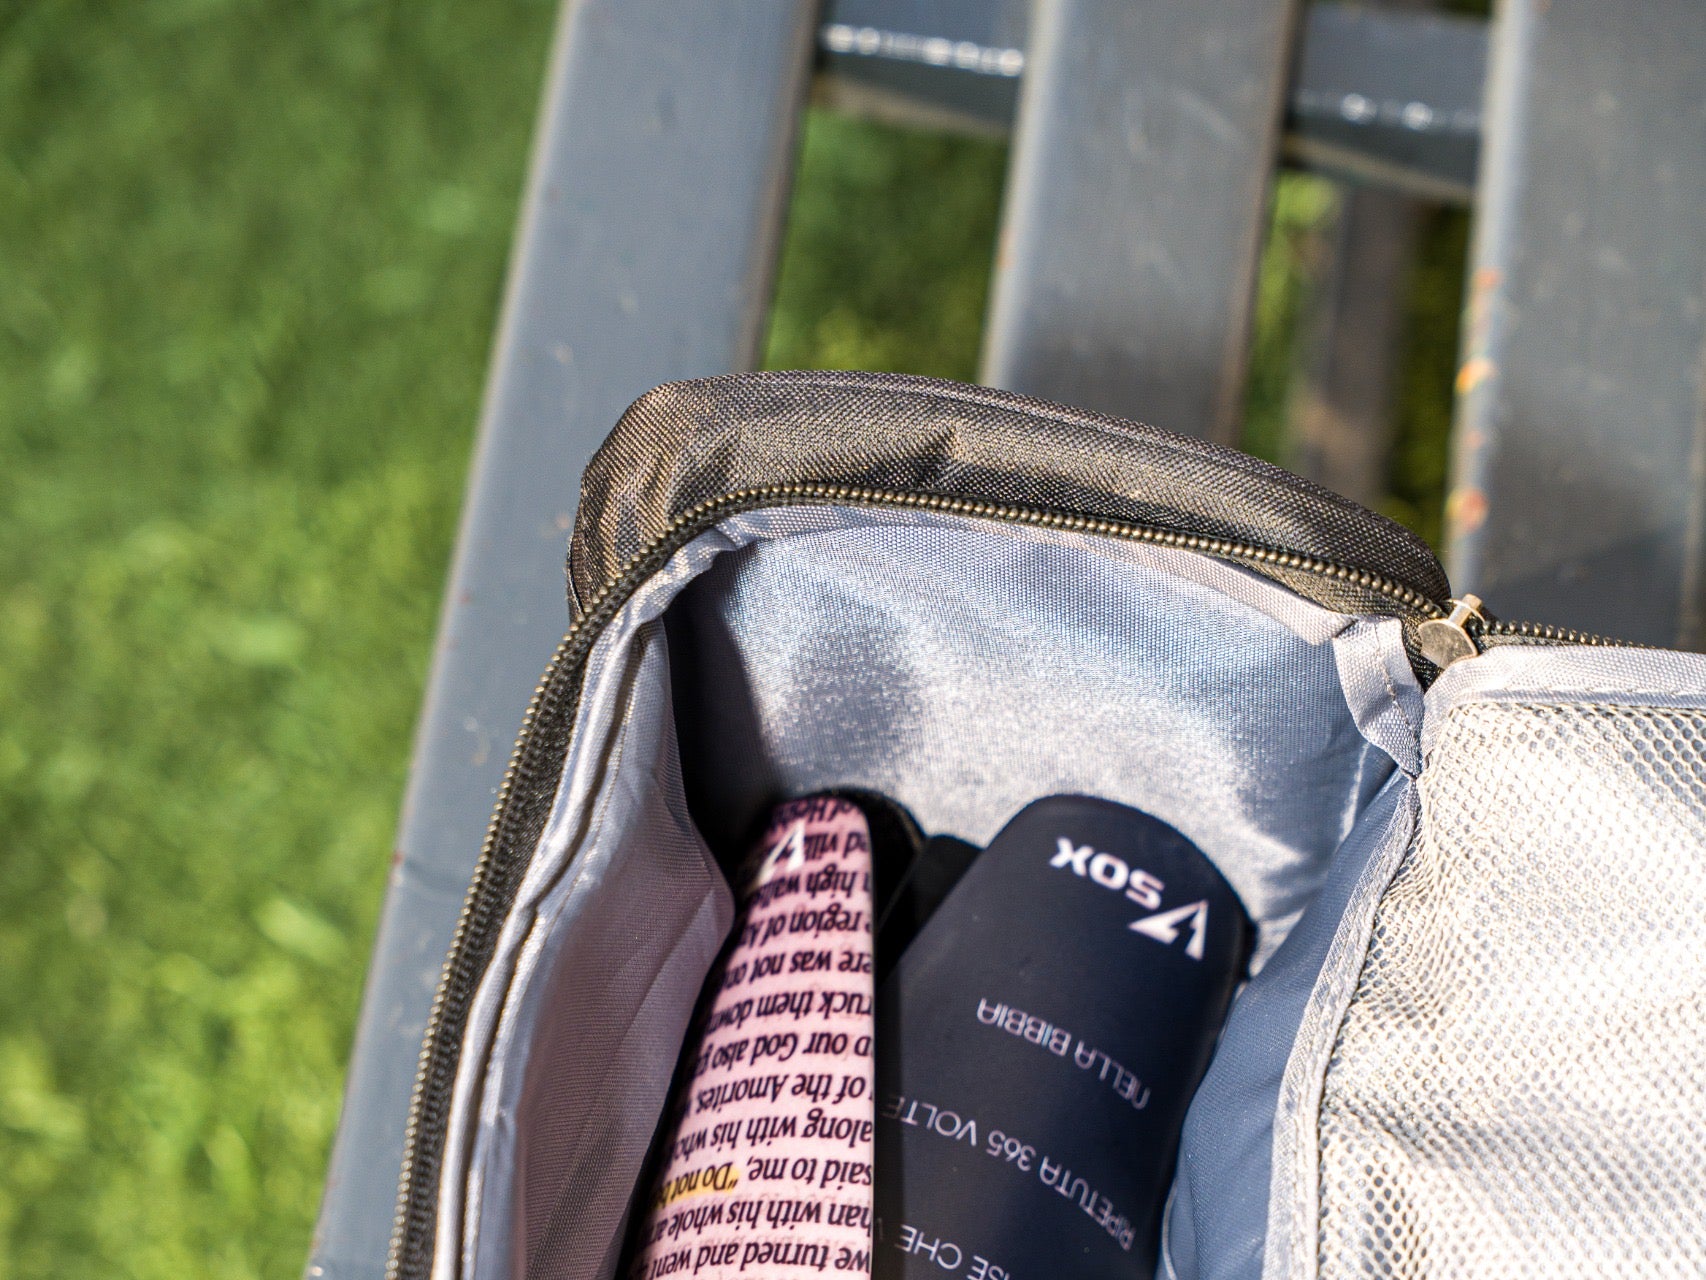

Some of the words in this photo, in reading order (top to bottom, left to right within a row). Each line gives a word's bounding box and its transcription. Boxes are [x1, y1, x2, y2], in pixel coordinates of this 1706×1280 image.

[806, 864, 856, 899] high
[1049, 838, 1165, 911] SOX
[759, 915, 786, 947] of
[789, 903, 861, 938] region
[749, 953, 786, 984] not
[789, 951, 831, 973] was
[756, 990, 814, 1020] them
[976, 998, 1071, 1056] BIBBIA
[750, 1033, 797, 1066] God
[803, 1032, 847, 1055] our
[791, 1074, 832, 1103] the
[833, 1075, 865, 1104] of
[1074, 1040, 1150, 1110] NELLA
[710, 1121, 742, 1152] his
[746, 1116, 796, 1147] with
[802, 1108, 871, 1148] along
[880, 1095, 977, 1147] VOLTE
[986, 1130, 1036, 1171] 365
[747, 1157, 789, 1181] me,
[791, 1159, 817, 1185] to
[820, 1159, 871, 1191] said
[670, 1171, 699, 1202] not
[727, 1201, 763, 1230] his
[766, 1201, 821, 1230] with
[1039, 1156, 1136, 1251] RIPETUTA
[667, 1202, 724, 1241] whole
[694, 1245, 738, 1275] and
[740, 1243, 828, 1273] turned
[835, 1248, 870, 1273] we
[894, 1224, 962, 1270] CHE
